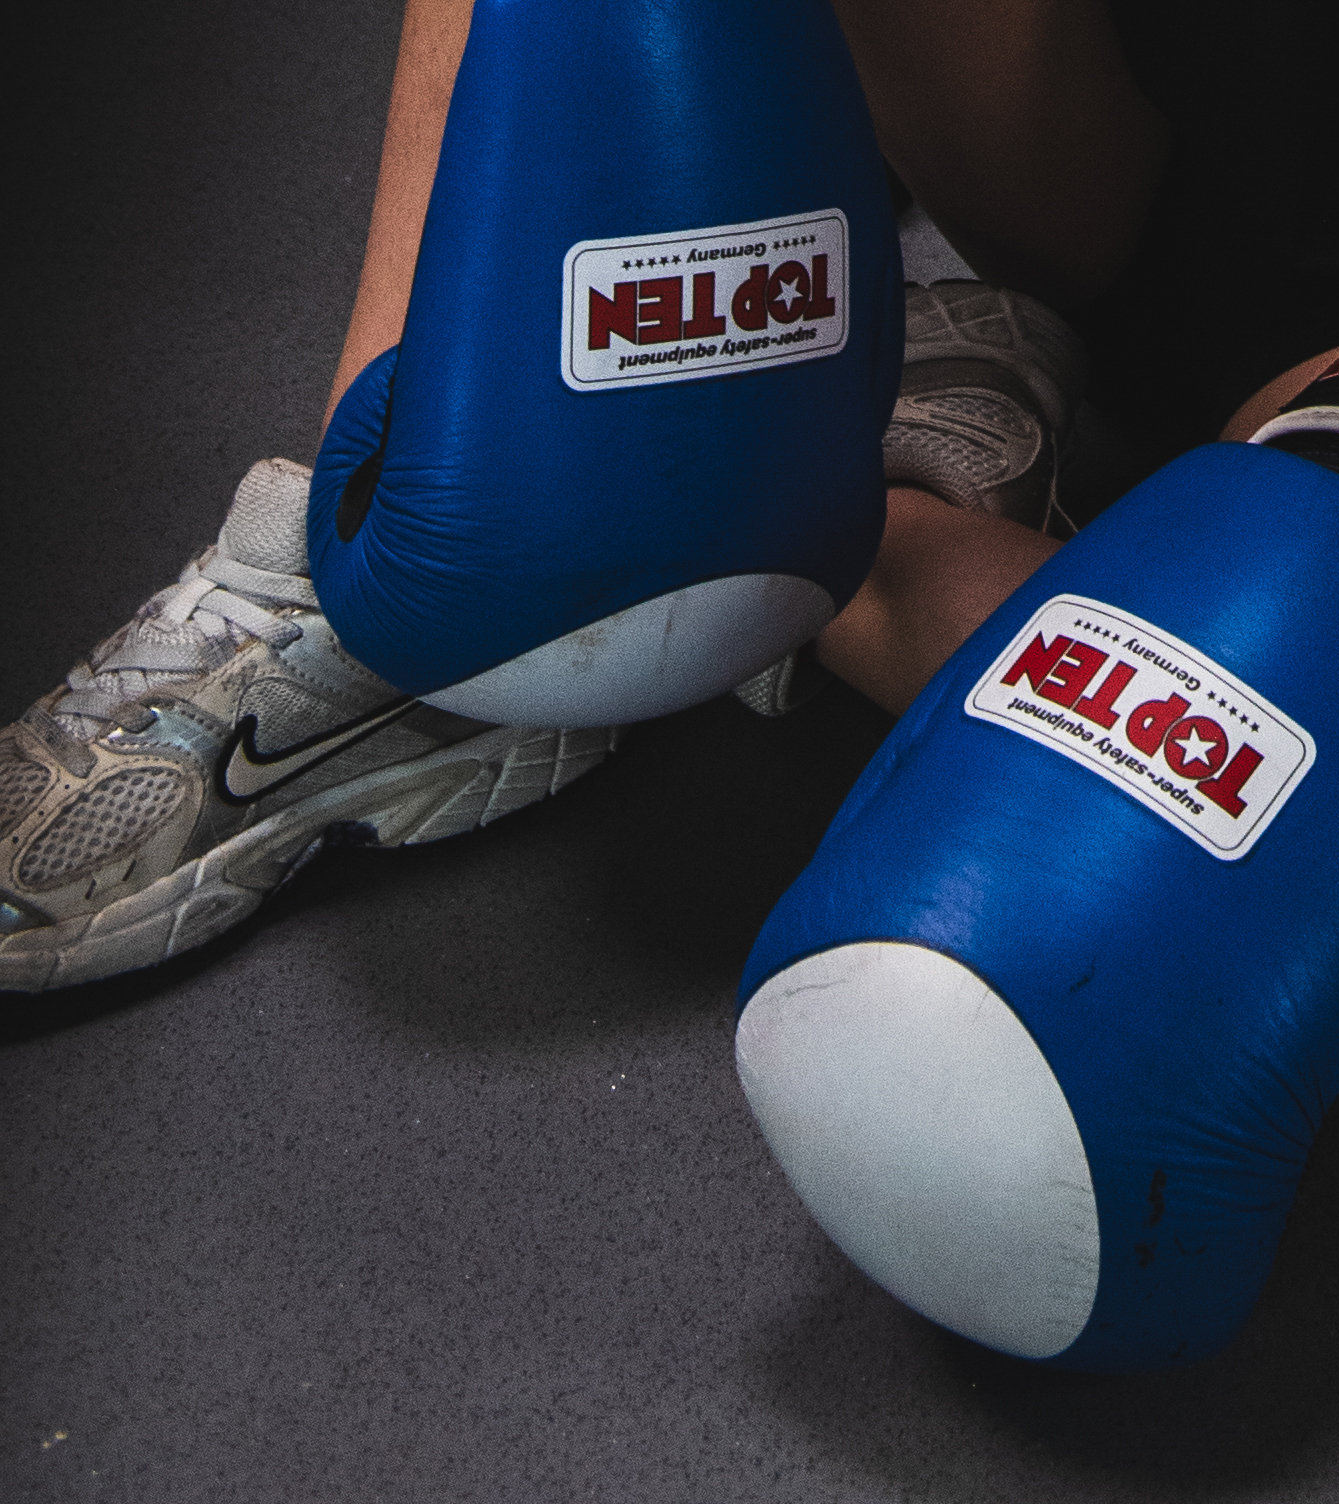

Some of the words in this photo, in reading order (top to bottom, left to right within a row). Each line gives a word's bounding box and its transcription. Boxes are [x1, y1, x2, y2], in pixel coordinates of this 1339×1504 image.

[687, 242, 766, 264] Germany
[587, 271, 727, 351] TEN
[731, 253, 836, 333] TOP
[619, 345, 718, 372] equipment
[720, 326, 818, 357] super-safety
[1000, 630, 1138, 732] TEN
[1123, 638, 1203, 692] Germany
[1007, 696, 1094, 744] equipment
[1093, 736, 1206, 816] super-safety
[1126, 691, 1266, 820] TOP
